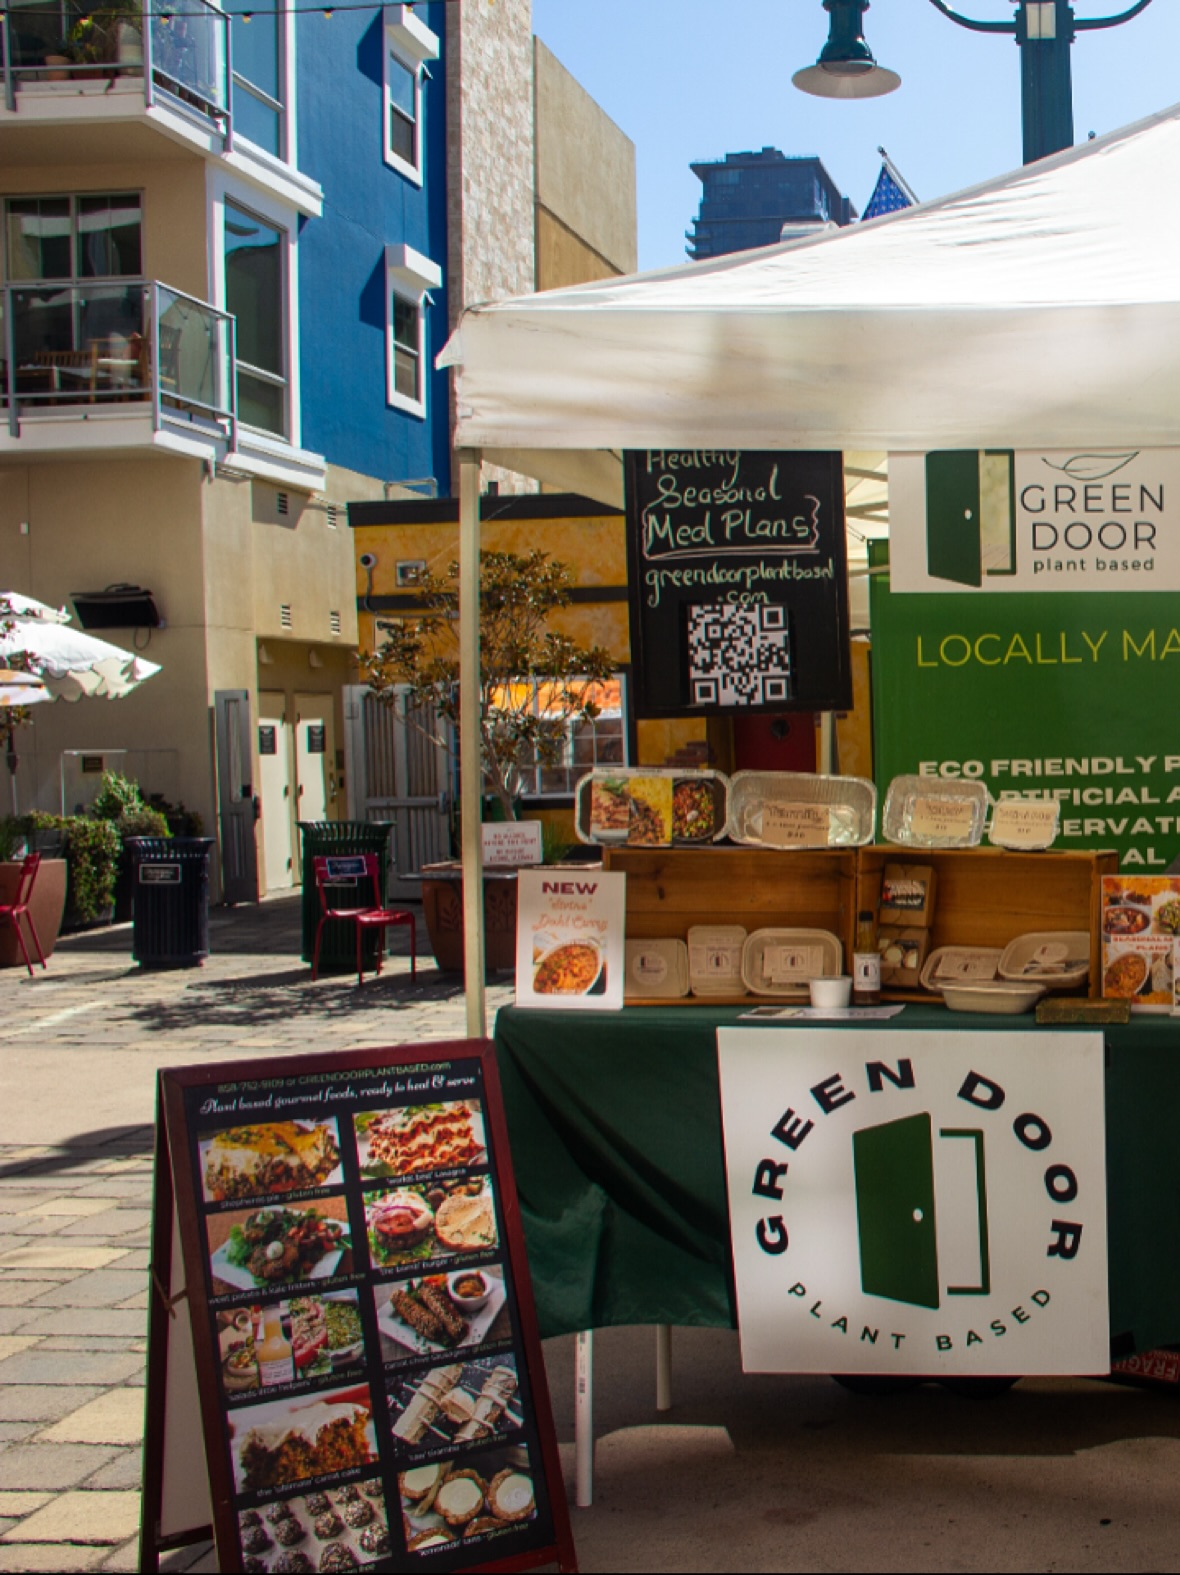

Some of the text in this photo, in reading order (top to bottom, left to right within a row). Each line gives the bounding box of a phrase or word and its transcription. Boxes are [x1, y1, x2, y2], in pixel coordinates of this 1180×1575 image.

[657, 464, 782, 508] Seasonal
[1020, 484, 1165, 513] GREEN
[721, 510, 810, 540] Plans
[1031, 522, 1157, 551] DOOR
[1033, 556, 1155, 575] plant based
[916, 630, 1108, 668] LOCALLY
[918, 761, 983, 779] ECO
[990, 755, 1157, 778] FRIENDLY
[541, 881, 599, 896] NEW
[751, 1058, 1084, 1261] GREEN DOOR
[787, 1281, 1051, 1352] PLANT BASED
